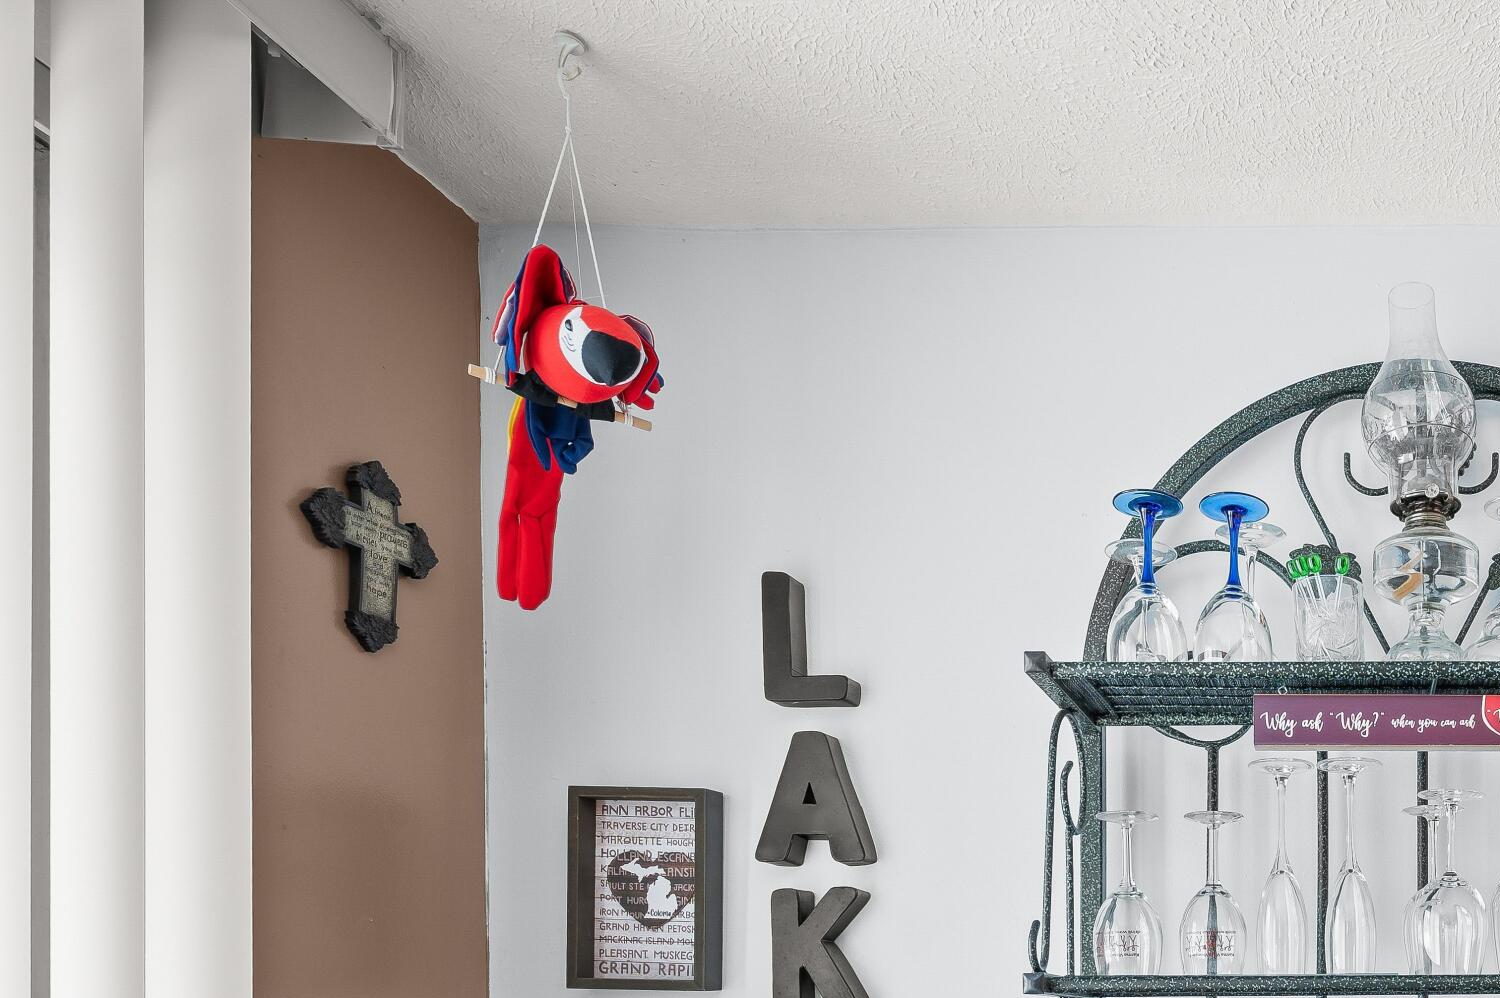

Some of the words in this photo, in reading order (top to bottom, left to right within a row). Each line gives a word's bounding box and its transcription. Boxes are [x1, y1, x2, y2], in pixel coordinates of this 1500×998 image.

[370, 549, 388, 563] love
[1260, 711, 1297, 737] Why
[1301, 711, 1323, 732] ask
[1391, 713, 1415, 729] when
[1418, 718, 1437, 733] you
[1440, 719, 1457, 729] can
[1459, 713, 1475, 729] ask
[601, 804, 629, 816] ANN
[634, 805, 673, 817] ARBOR
[601, 820, 647, 831] TRAVERSE
[600, 835, 662, 846] MARQUETTE
[600, 848, 652, 862] HOLLAND
[628, 882, 645, 891] STE
[600, 893, 623, 903] PORT
[599, 922, 630, 931] GRAND
[633, 923, 664, 933] HAVEN
[645, 936, 674, 946] ISLAND
[653, 950, 694, 961] MUSKEG
[598, 960, 650, 974] GRAND
